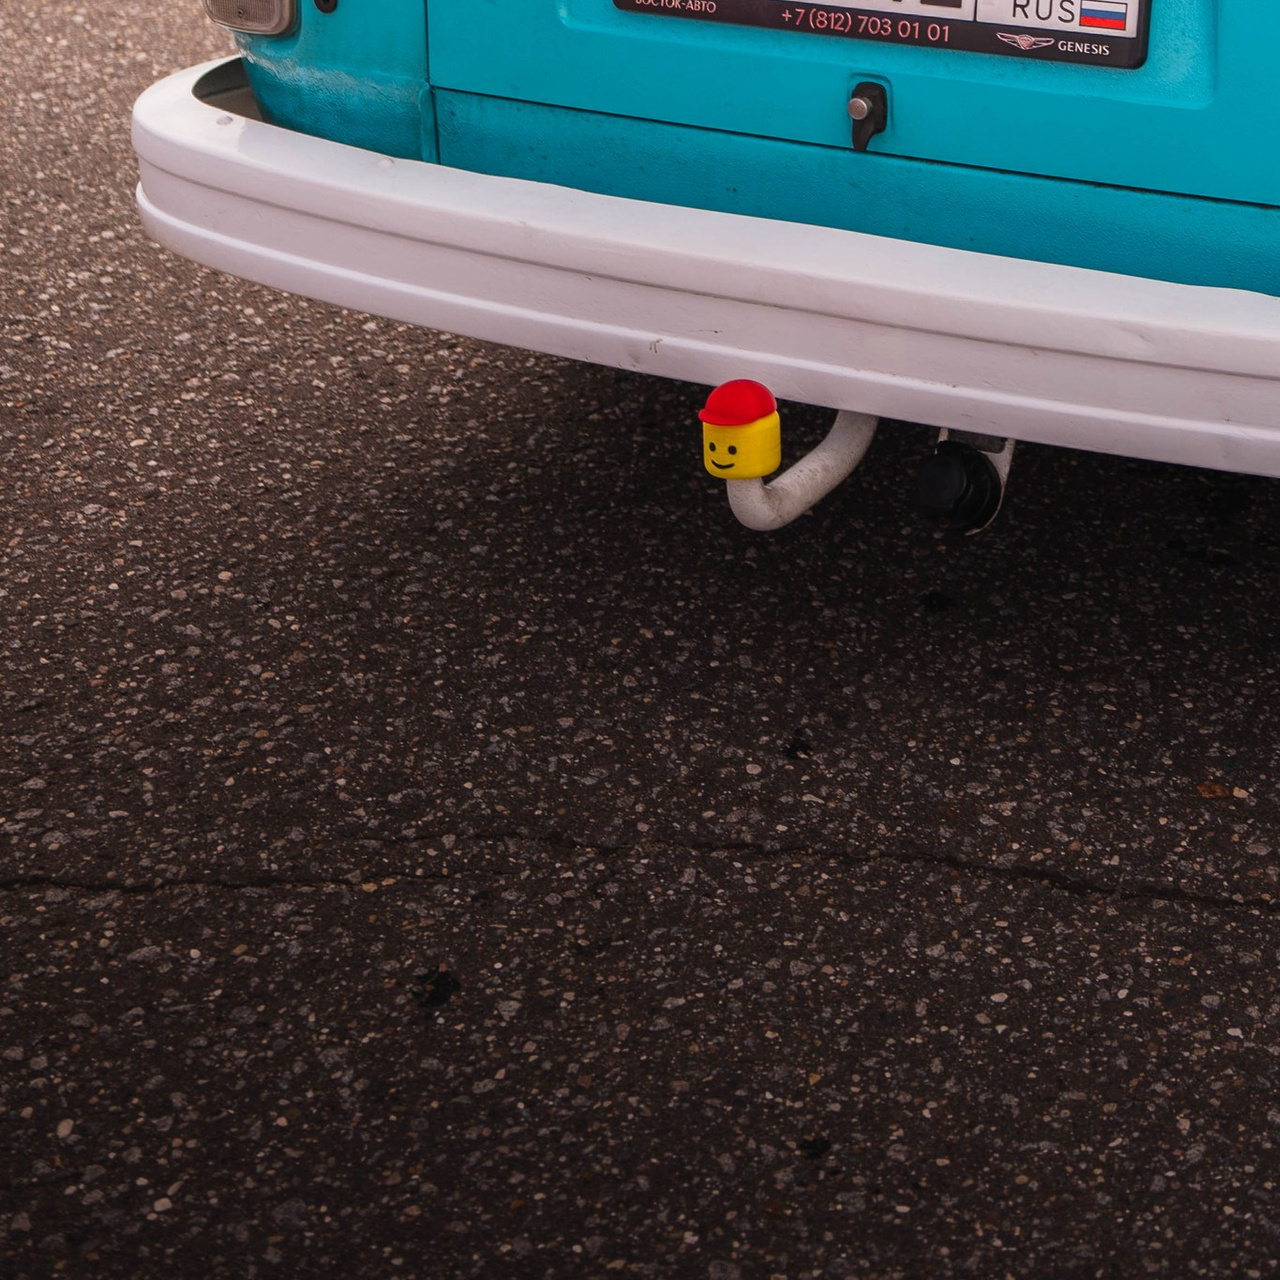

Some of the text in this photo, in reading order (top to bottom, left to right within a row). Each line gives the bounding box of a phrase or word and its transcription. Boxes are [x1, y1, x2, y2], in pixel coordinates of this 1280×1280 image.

[782, 7, 950, 42] +7 (812) 703 01 01
[1058, 40, 1110, 56] GENESIS
